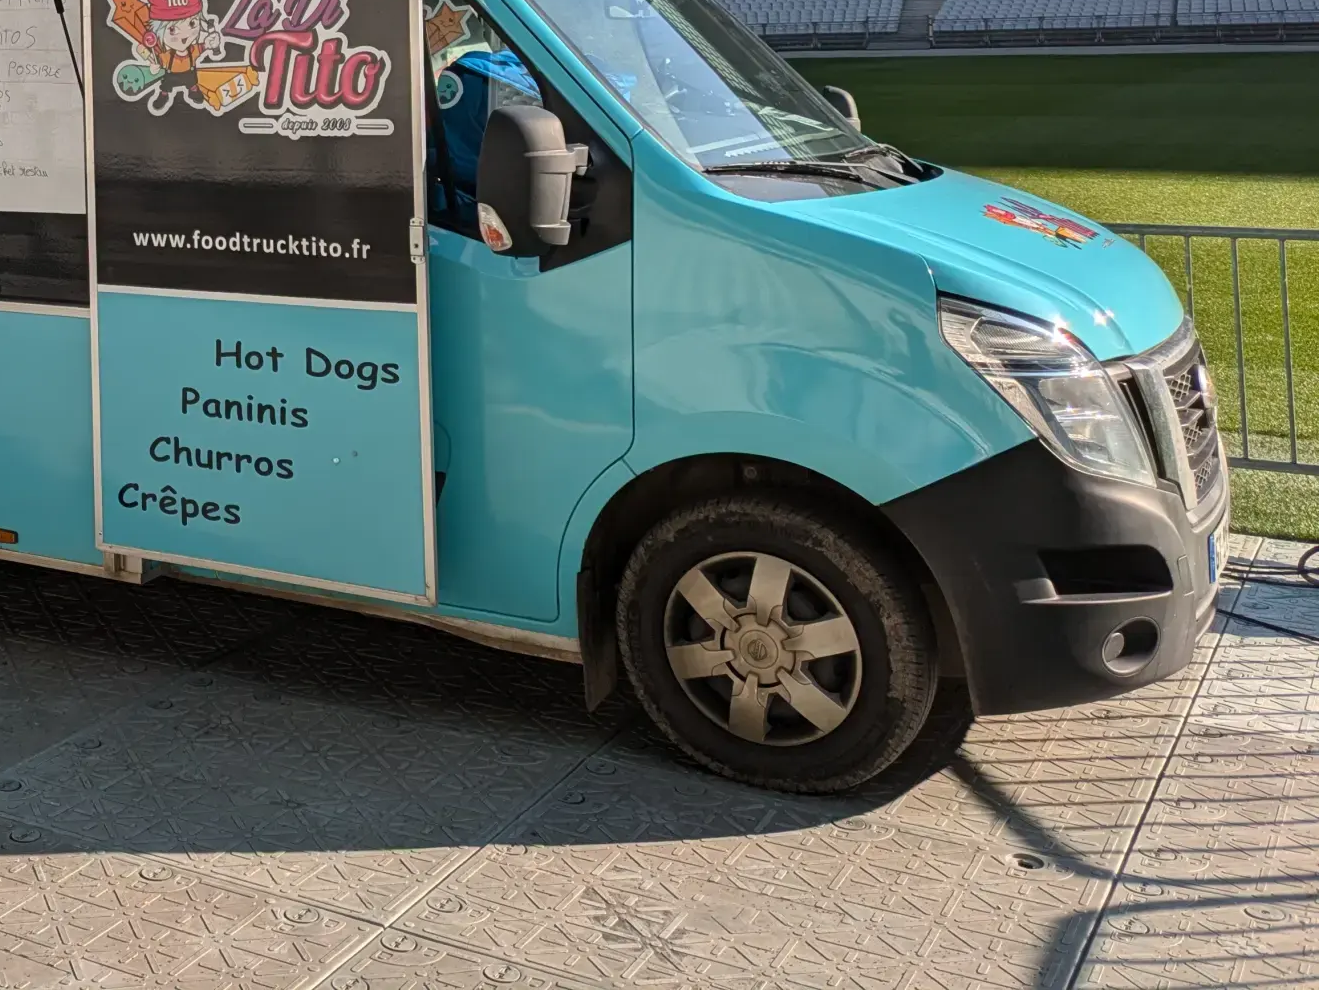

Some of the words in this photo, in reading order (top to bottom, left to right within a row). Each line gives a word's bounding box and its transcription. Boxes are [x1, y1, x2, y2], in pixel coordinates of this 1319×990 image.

[8, 61, 62, 79] POSSIBLE
[251, 30, 381, 106] Tito
[282, 118, 318, 133] depuis
[321, 118, 352, 131] 2008
[133, 229, 371, 260] www.foodtrucktito.fr
[215, 339, 284, 372] Hot
[305, 347, 400, 391] Dogs
[182, 387, 309, 428] Paninis
[149, 436, 294, 479] Churros
[118, 483, 241, 526] Crêpes
